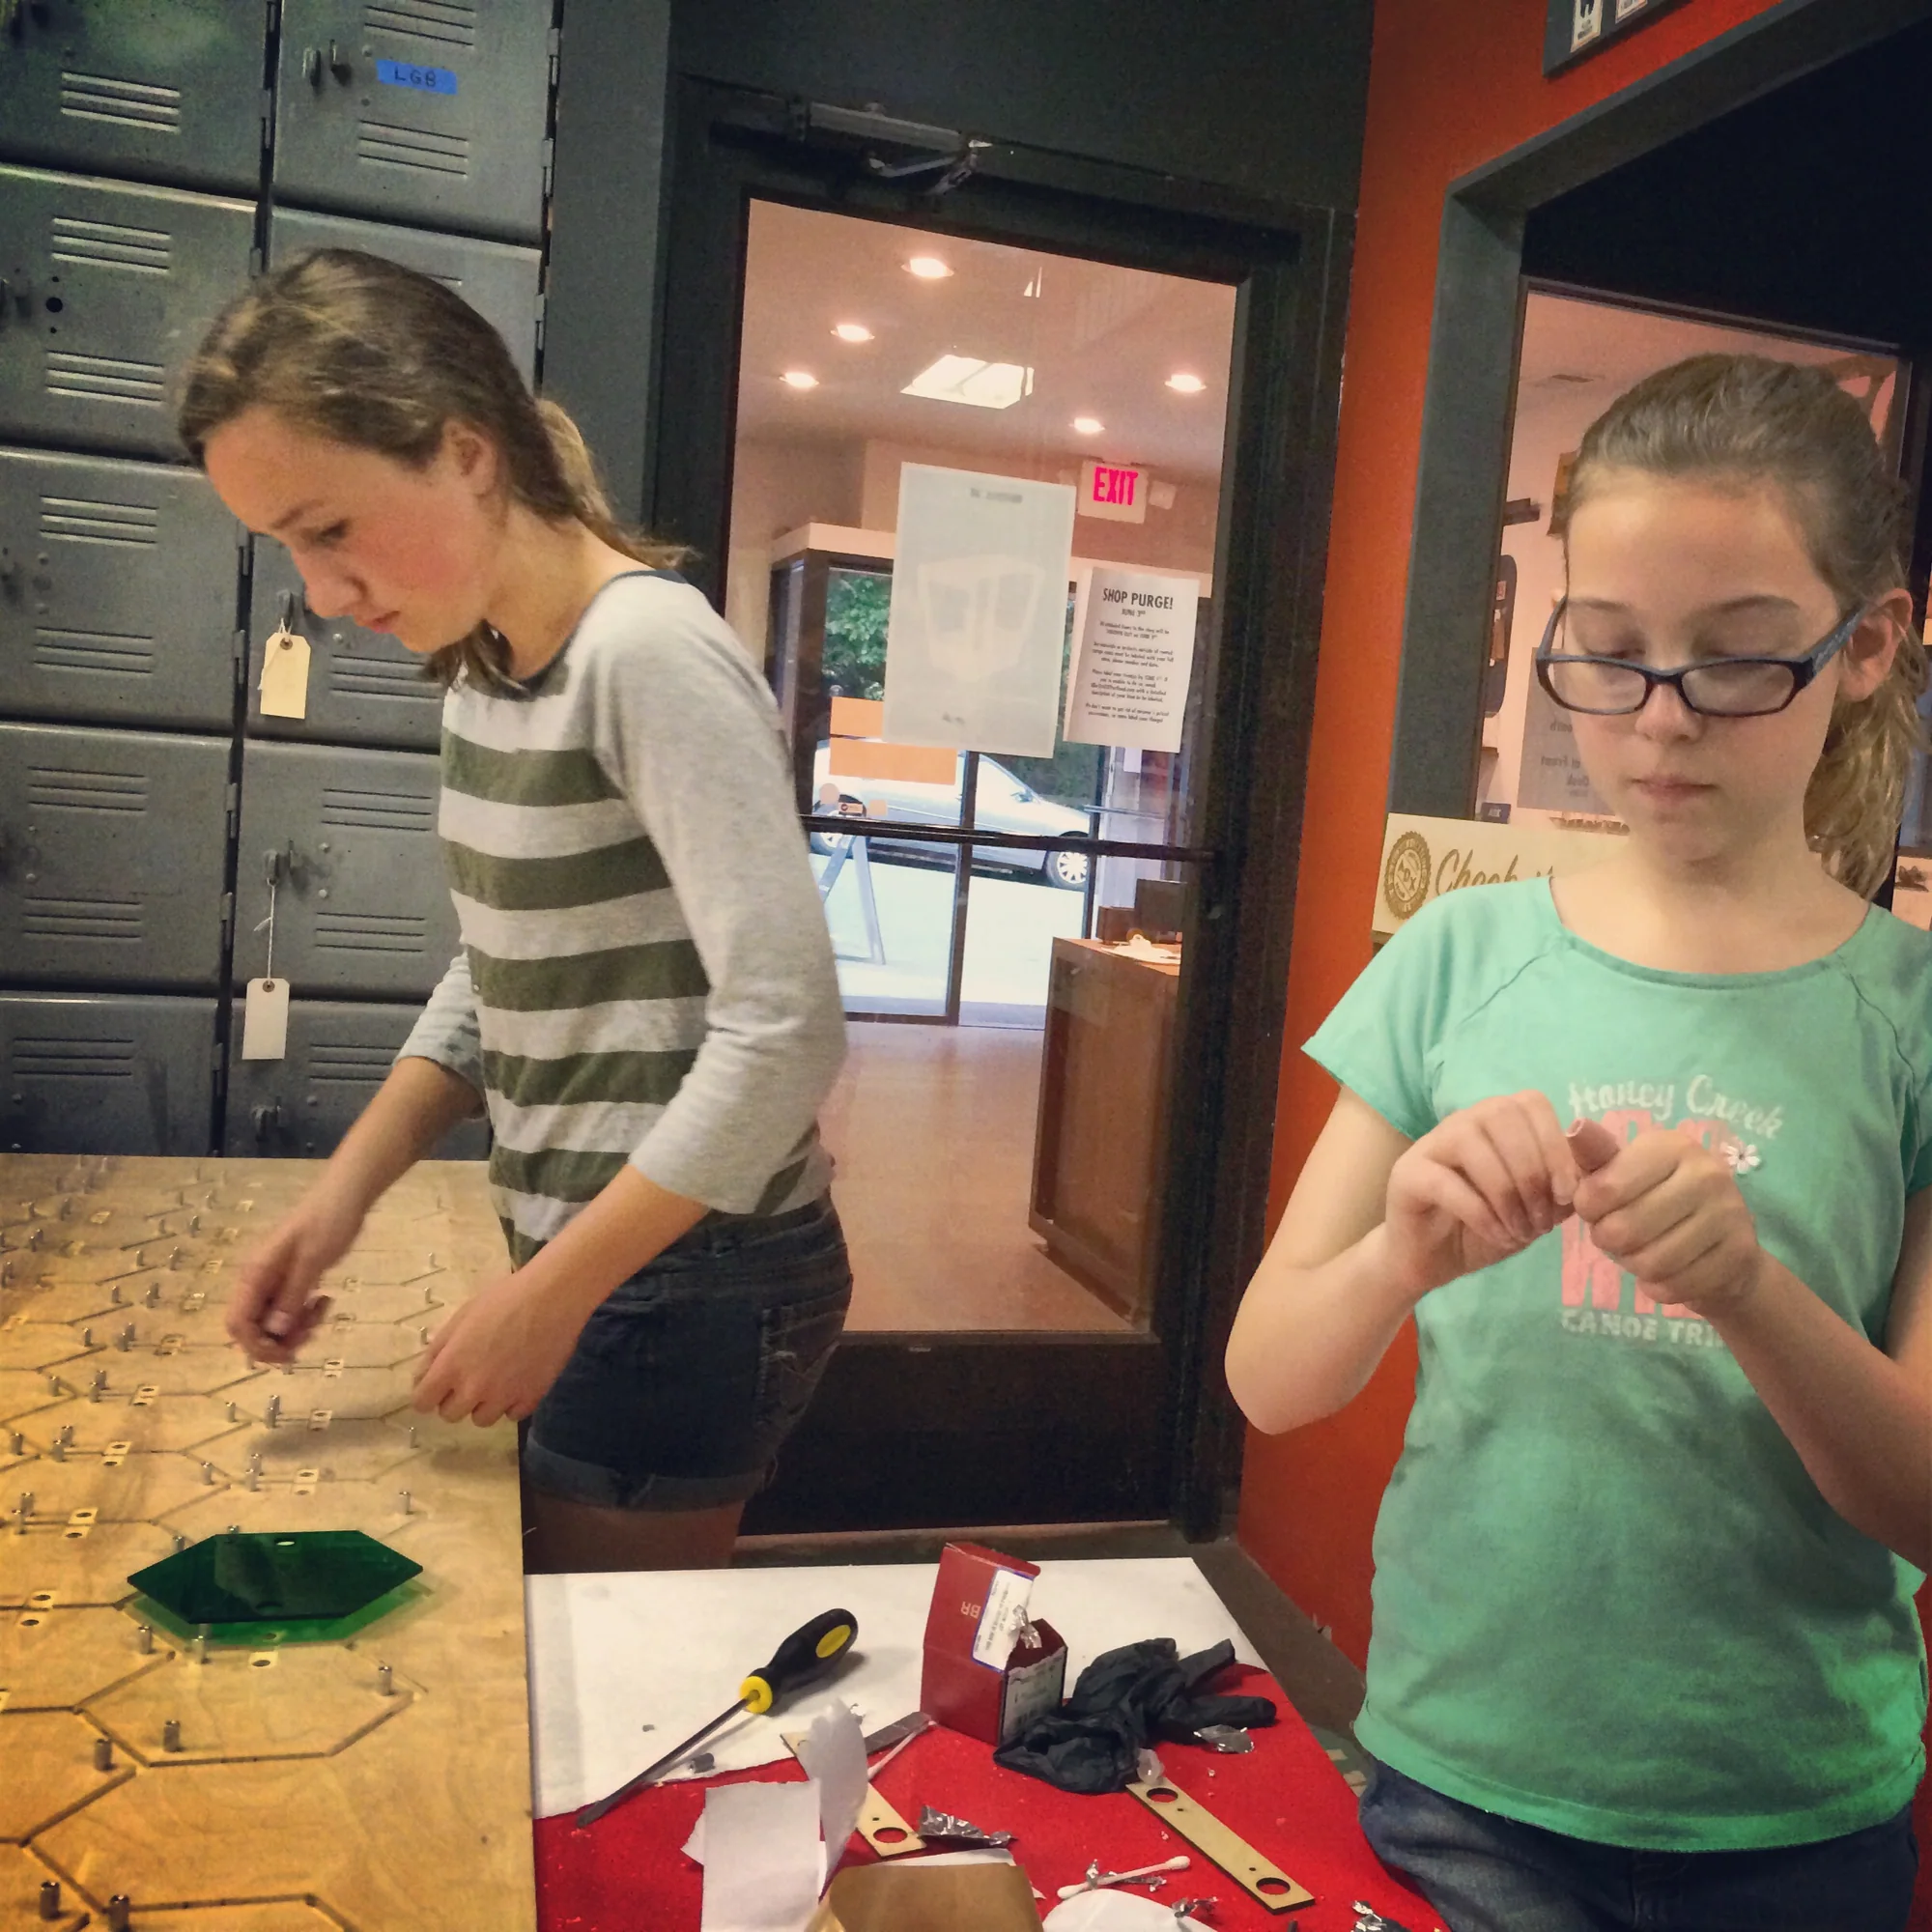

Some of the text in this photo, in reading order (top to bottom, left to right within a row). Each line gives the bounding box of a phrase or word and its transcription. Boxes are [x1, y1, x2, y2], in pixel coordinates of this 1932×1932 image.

[1093, 466, 1138, 506] EXIT
[1102, 587, 1174, 610] SHOP PURGE!
[1561, 1308, 1659, 1341] CANOE
